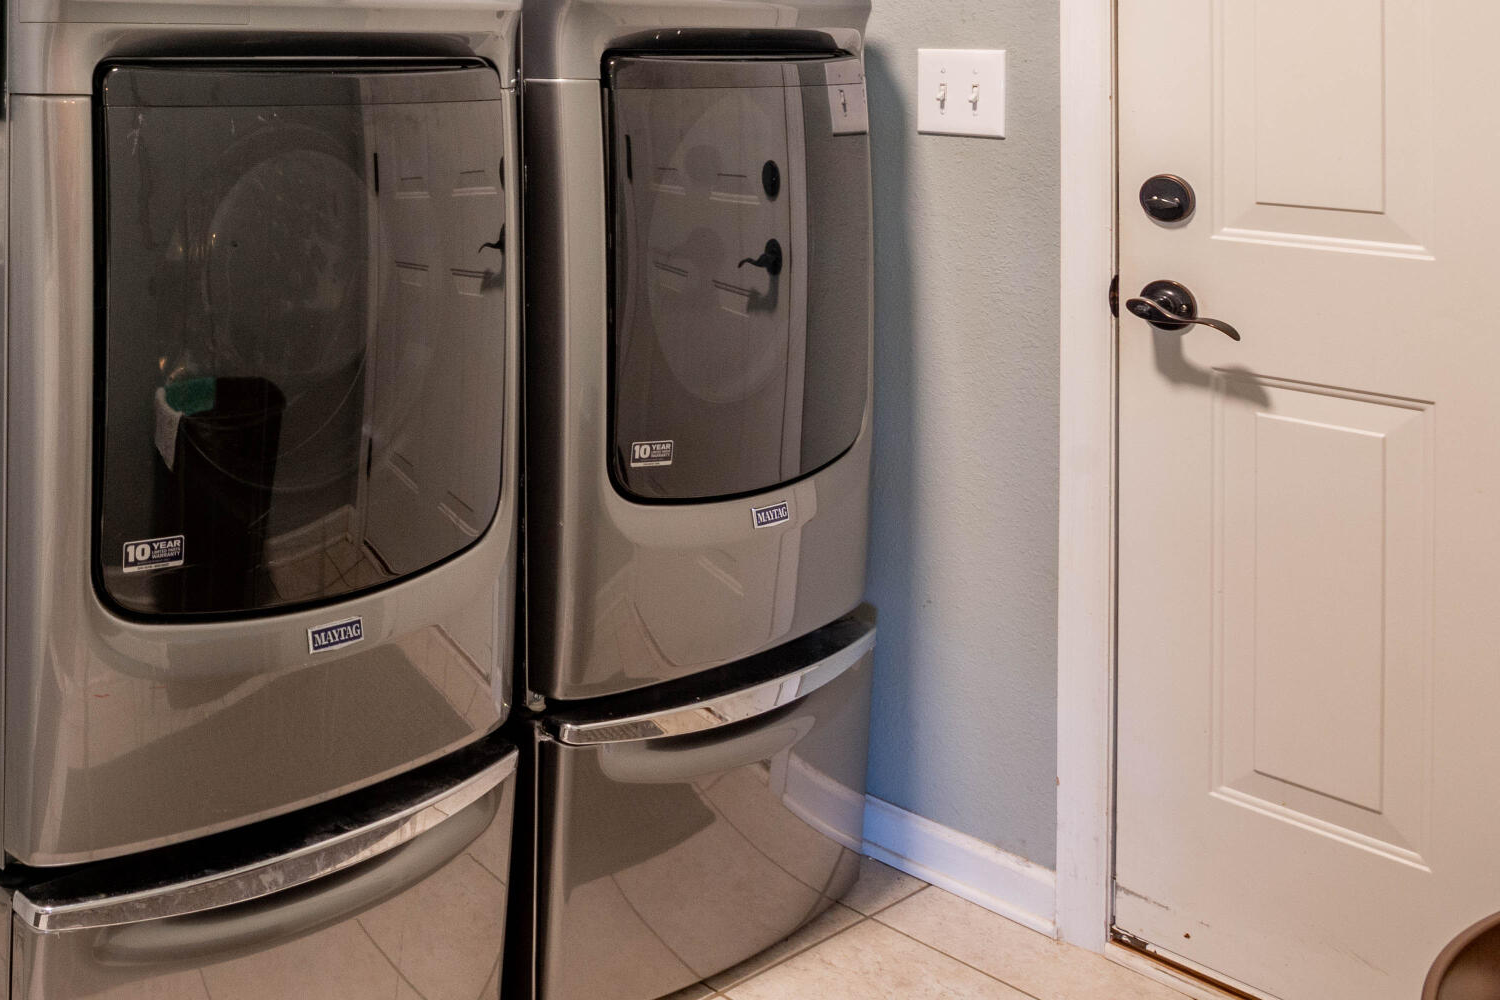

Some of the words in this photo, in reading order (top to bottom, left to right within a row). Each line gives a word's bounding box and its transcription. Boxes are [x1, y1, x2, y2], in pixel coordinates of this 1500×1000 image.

[634, 444, 651, 460] 10
[651, 443, 671, 451] YEAR
[757, 506, 787, 524] MAYTAG
[126, 543, 151, 563] 10
[152, 539, 181, 550] YEAR
[151, 551, 181, 560] WARRANTY
[313, 623, 361, 647] MAYTAG
